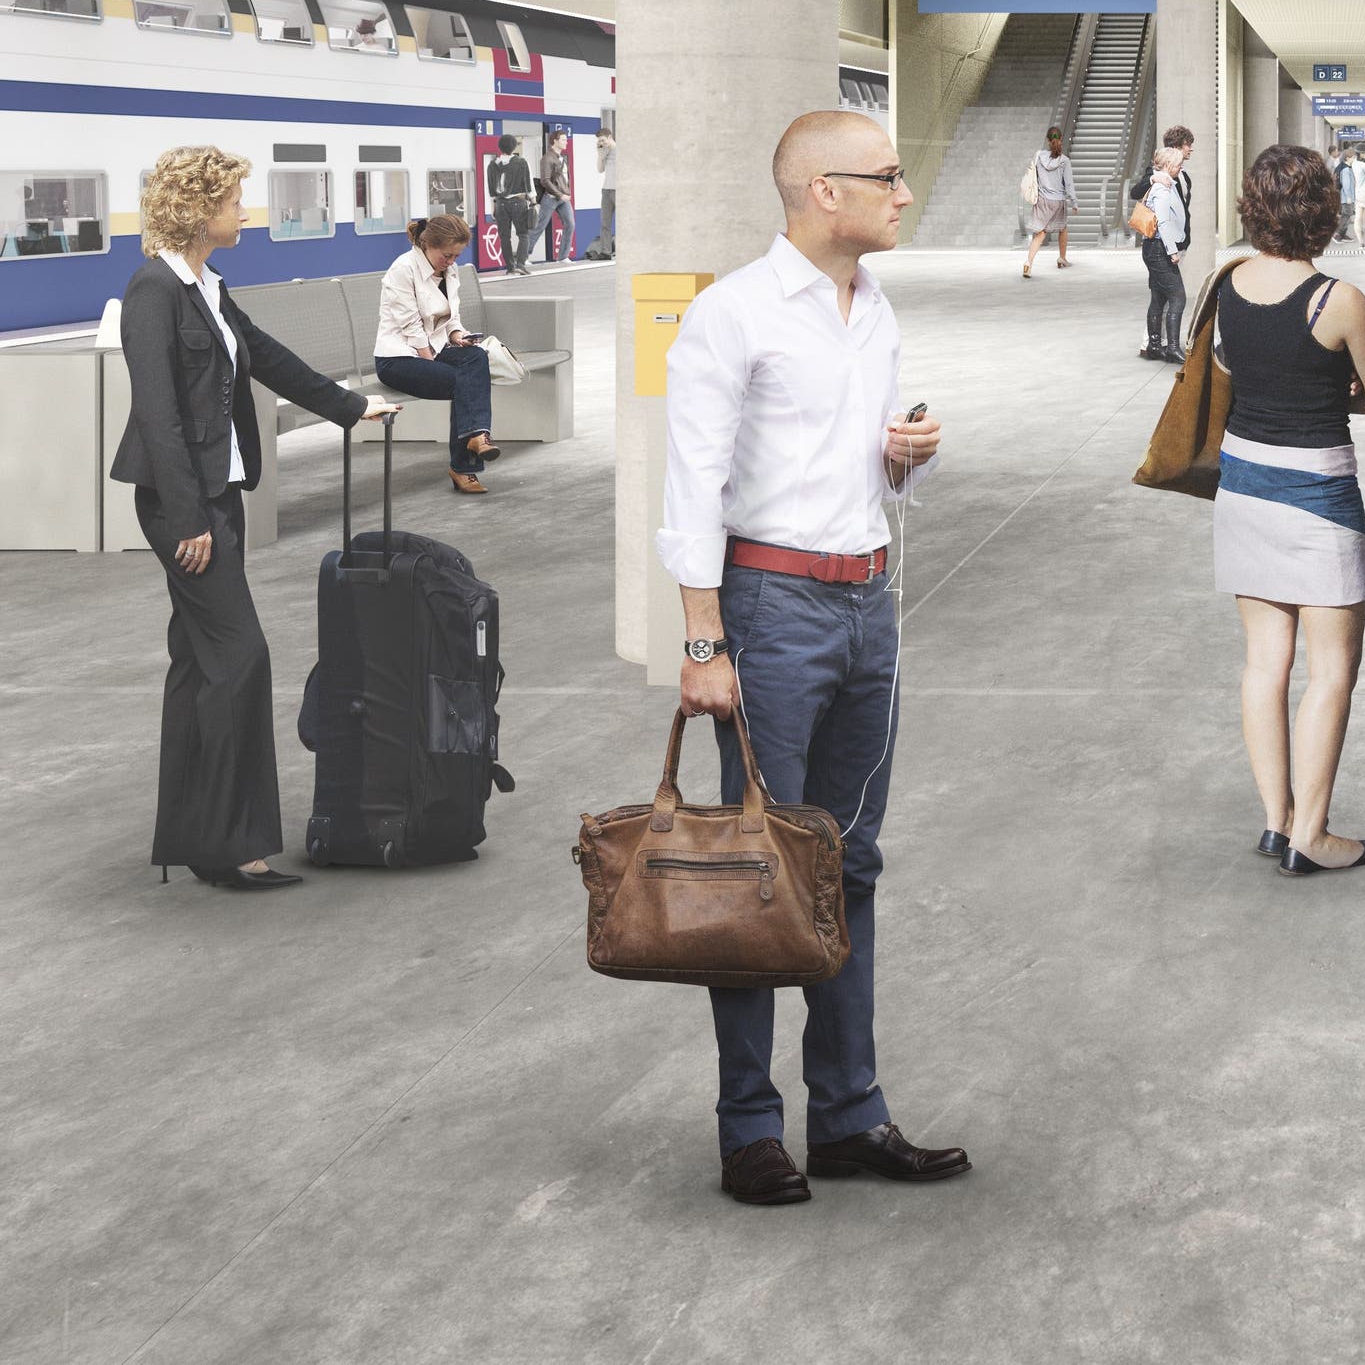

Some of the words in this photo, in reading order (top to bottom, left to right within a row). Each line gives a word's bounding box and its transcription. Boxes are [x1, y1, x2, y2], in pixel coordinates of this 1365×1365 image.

[1319, 71, 1326, 79] D
[1332, 71, 1343, 79] 22
[497, 81, 502, 94] 1
[478, 123, 483, 133] 2
[567, 128, 572, 137] 2
